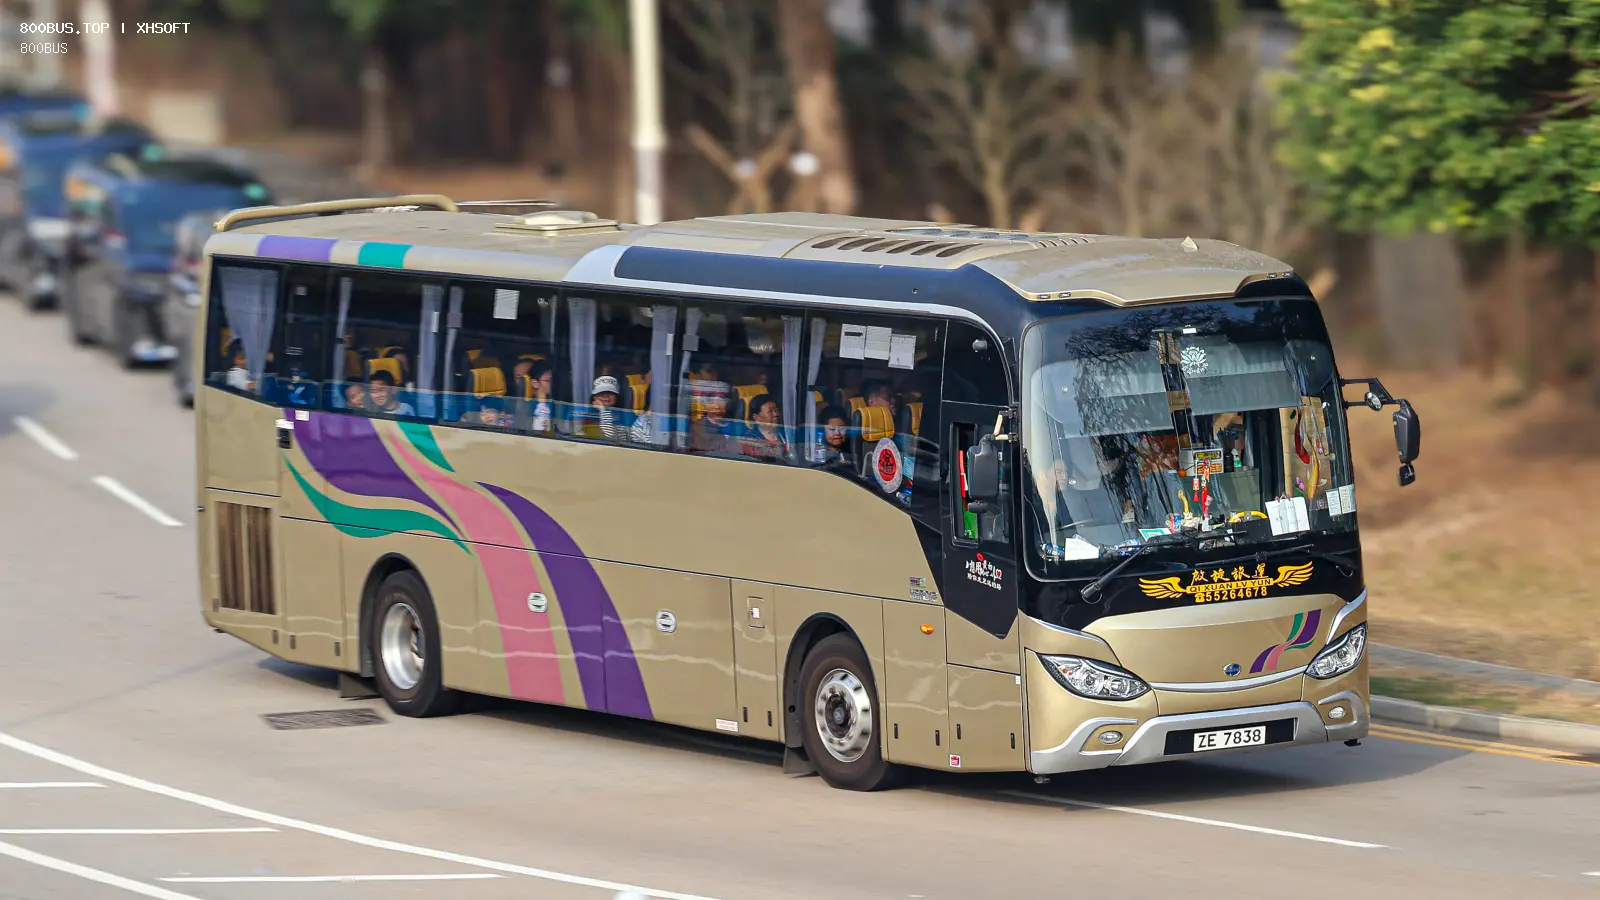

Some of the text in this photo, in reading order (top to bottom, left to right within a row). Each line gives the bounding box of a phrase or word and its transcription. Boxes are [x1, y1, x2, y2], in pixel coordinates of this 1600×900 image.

[1204, 583, 1233, 592] XUAN
[1205, 586, 1267, 602] 55264678
[1198, 729, 1261, 749] ZE 7838
